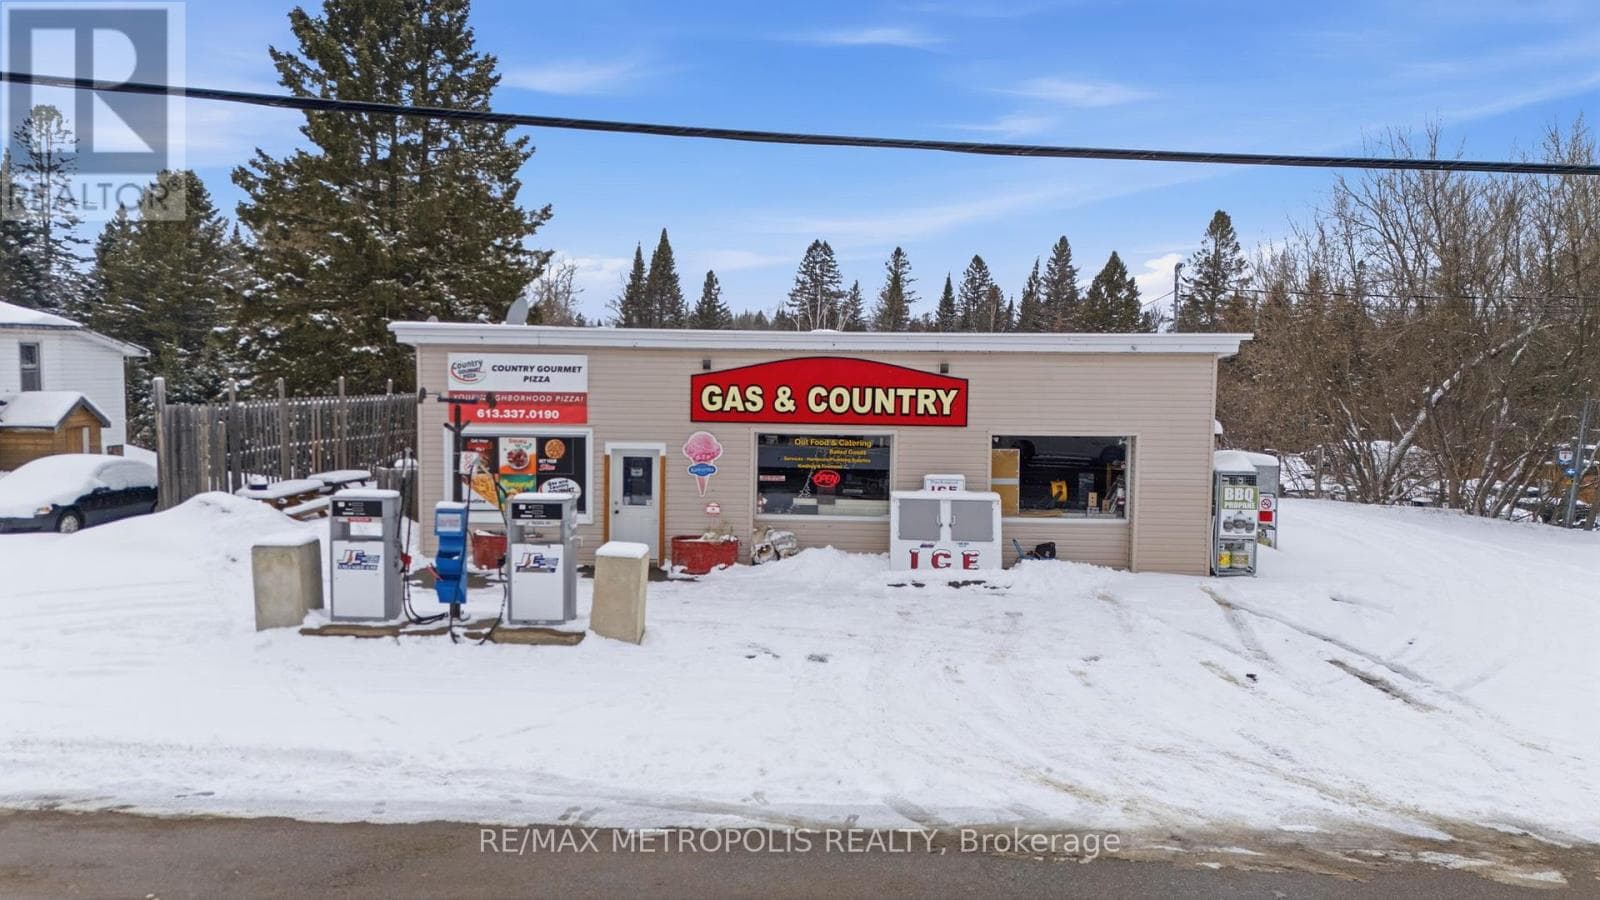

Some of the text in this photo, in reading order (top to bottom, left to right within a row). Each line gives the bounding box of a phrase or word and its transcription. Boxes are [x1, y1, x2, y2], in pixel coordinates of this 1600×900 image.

[491, 364, 583, 374] COUNTRY GOURMET
[523, 375, 551, 383] PIZZA
[555, 395, 584, 403] PIZZA!
[701, 384, 959, 415] GAS & COUNTRY
[476, 409, 560, 419] 613.337.0190
[810, 438, 831, 447] Food
[838, 439, 873, 448] Catering
[814, 474, 838, 484] OPEN
[1224, 487, 1254, 502] BBQ
[909, 548, 981, 570] ICE
